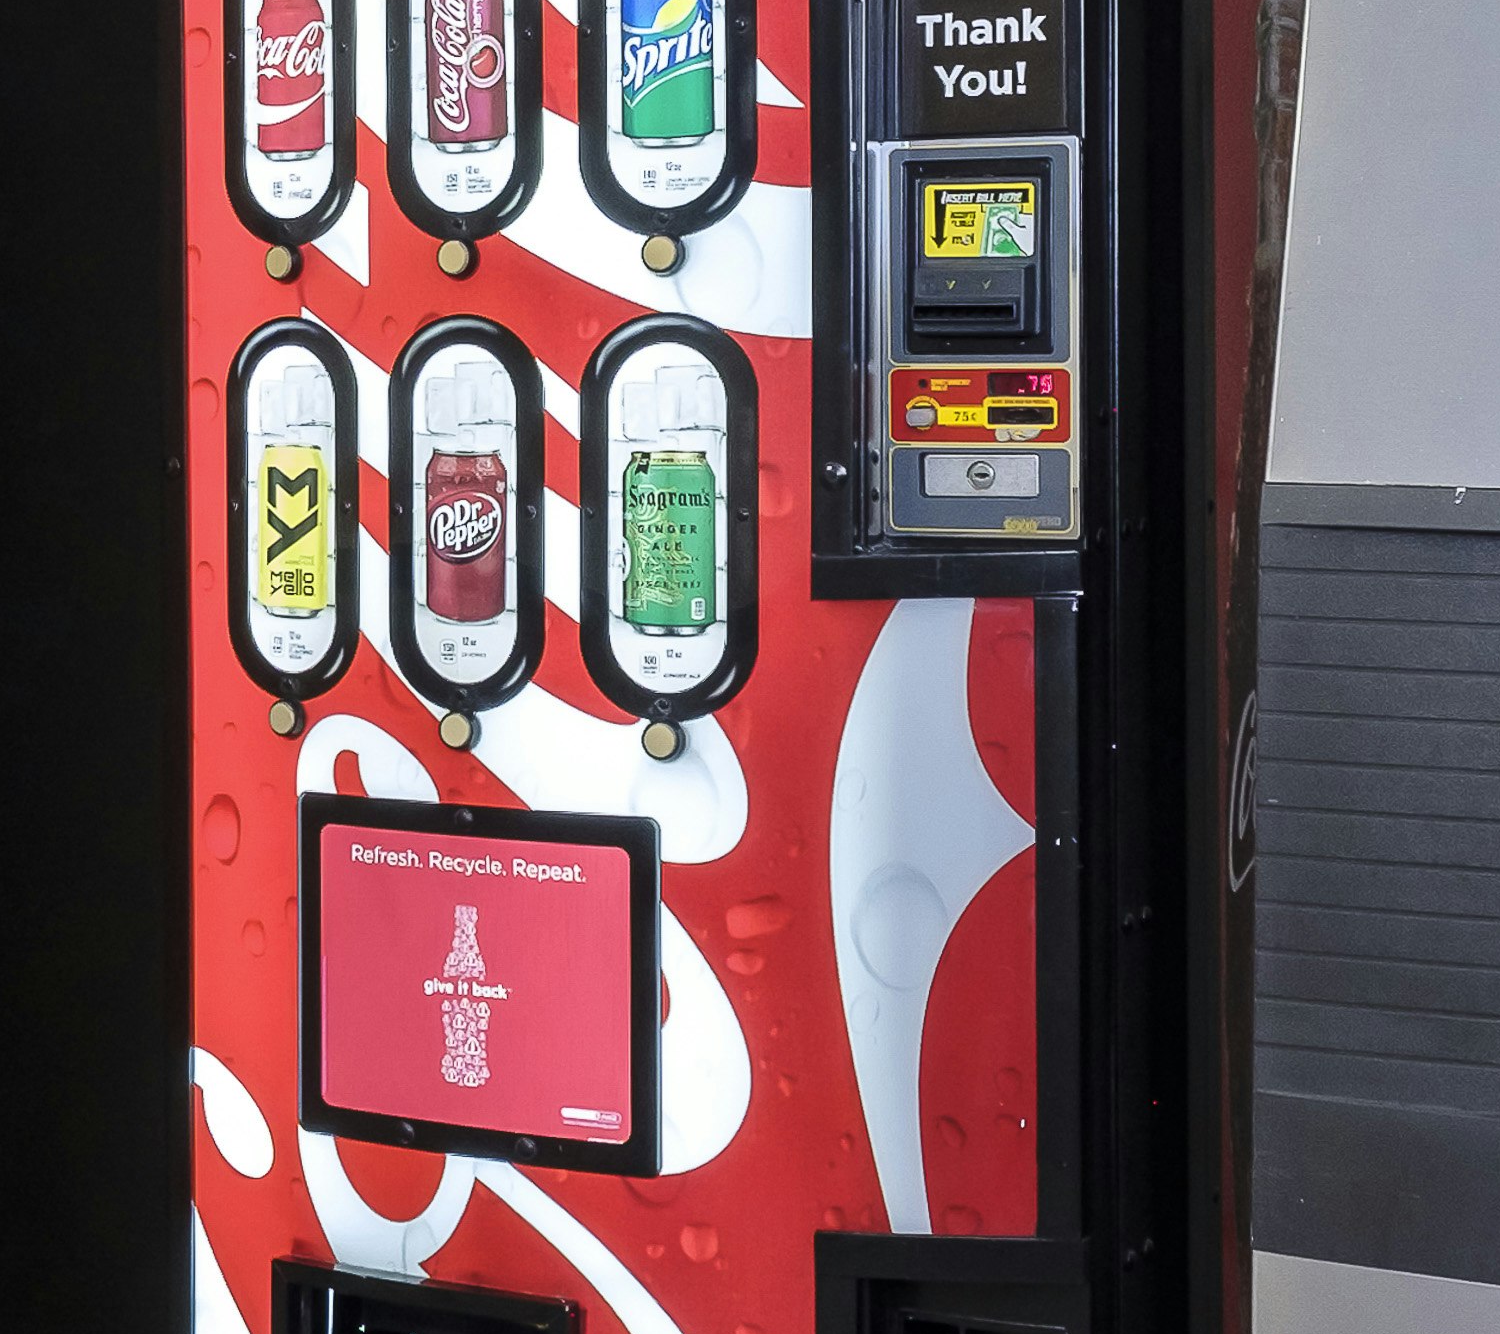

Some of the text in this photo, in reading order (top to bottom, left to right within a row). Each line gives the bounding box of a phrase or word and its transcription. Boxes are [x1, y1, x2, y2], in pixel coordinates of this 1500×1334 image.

[916, 7, 1047, 47] Thank
[257, 21, 325, 79] oca-Col
[622, 9, 713, 92] Sprite
[933, 61, 1027, 98] You!
[941, 191, 1023, 204] INSERT BILL HERE
[453, 499, 483, 527] Dr
[629, 484, 711, 511] Seagram's
[436, 505, 498, 551] Pepper
[637, 524, 697, 534] GINGER
[652, 541, 682, 551] ALE
[351, 844, 587, 883] Refresh. Recycle. Repeat.
[423, 978, 508, 1000] give it back
